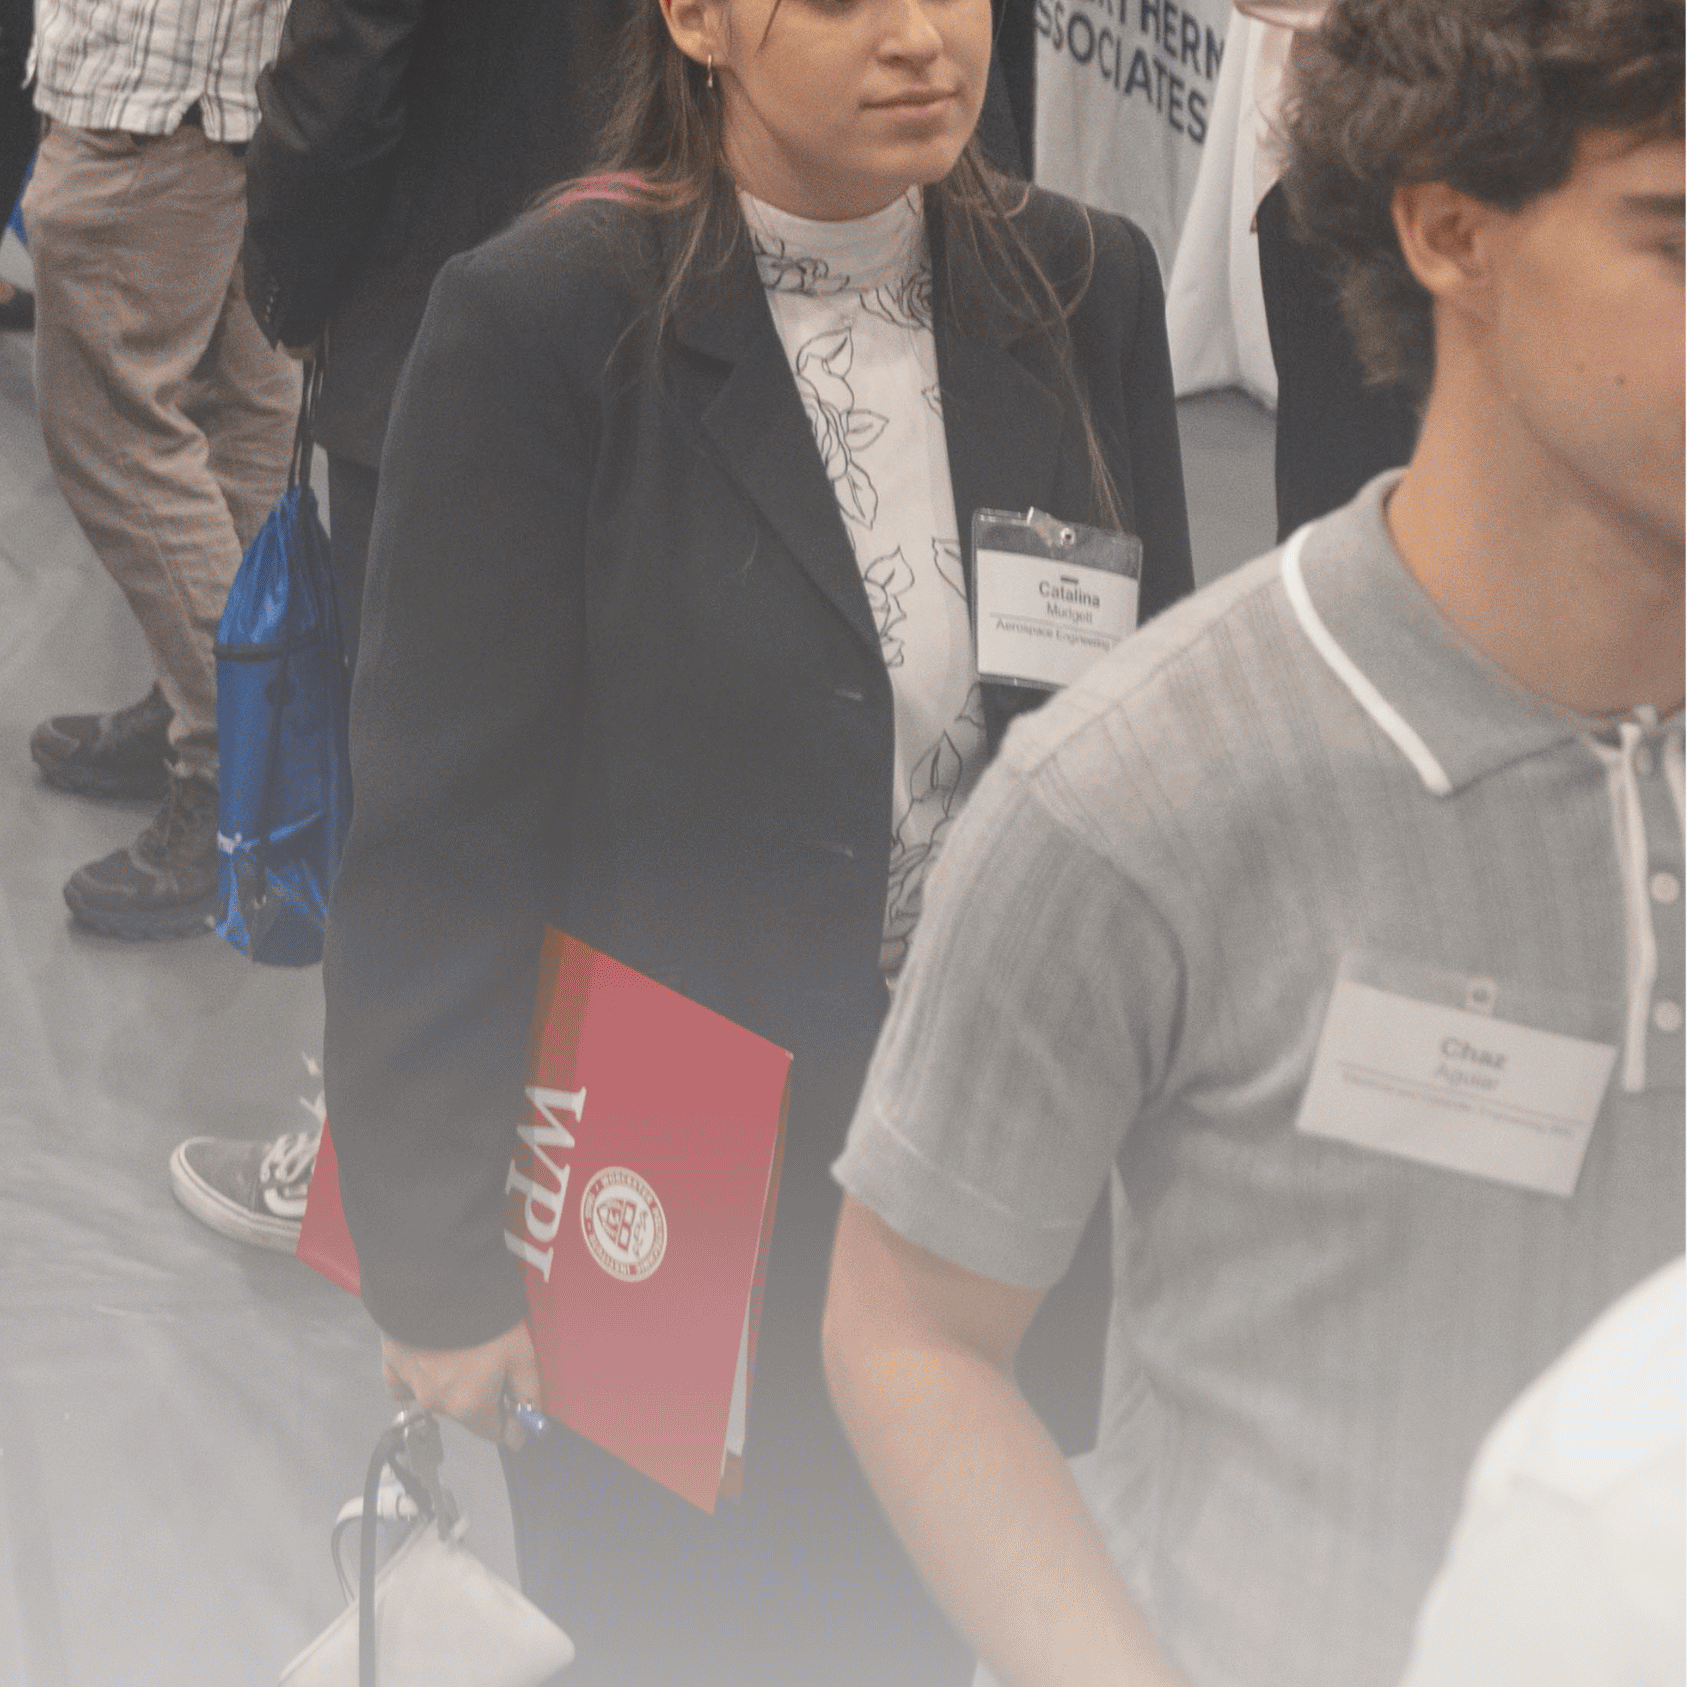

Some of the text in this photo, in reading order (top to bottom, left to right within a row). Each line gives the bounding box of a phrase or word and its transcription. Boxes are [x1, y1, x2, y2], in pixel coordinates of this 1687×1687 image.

[1038, 579, 1101, 609] Catalina
[995, 616, 1111, 653] Aerospace Engineering
[1441, 1035, 1507, 1070] Chaz
[504, 1085, 587, 1284] WPI
